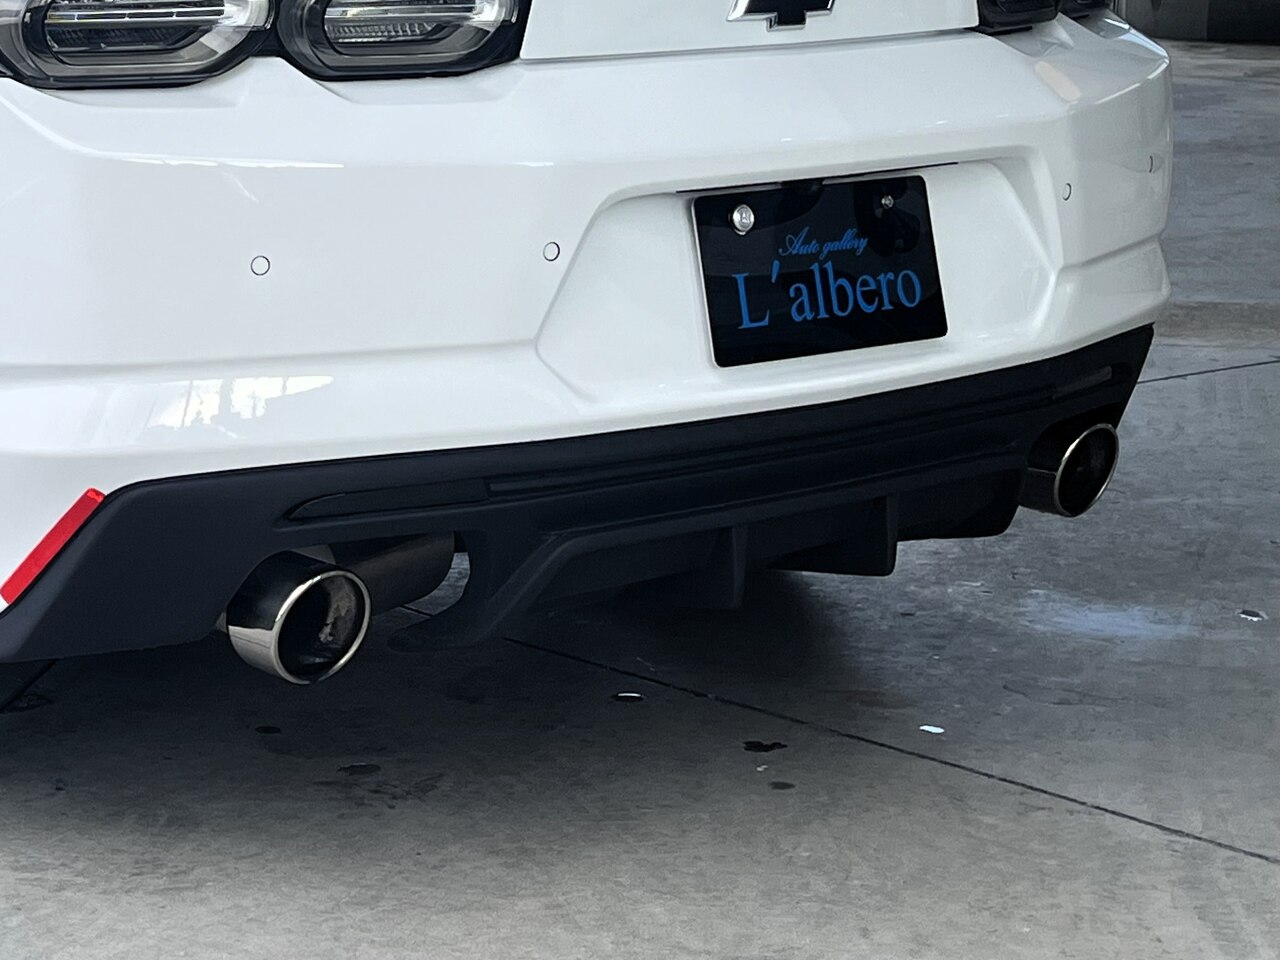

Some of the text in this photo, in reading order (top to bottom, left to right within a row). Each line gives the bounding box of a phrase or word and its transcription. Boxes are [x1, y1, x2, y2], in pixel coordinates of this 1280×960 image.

[779, 227, 868, 260] Auto gallery
[731, 260, 921, 329] L'albero
